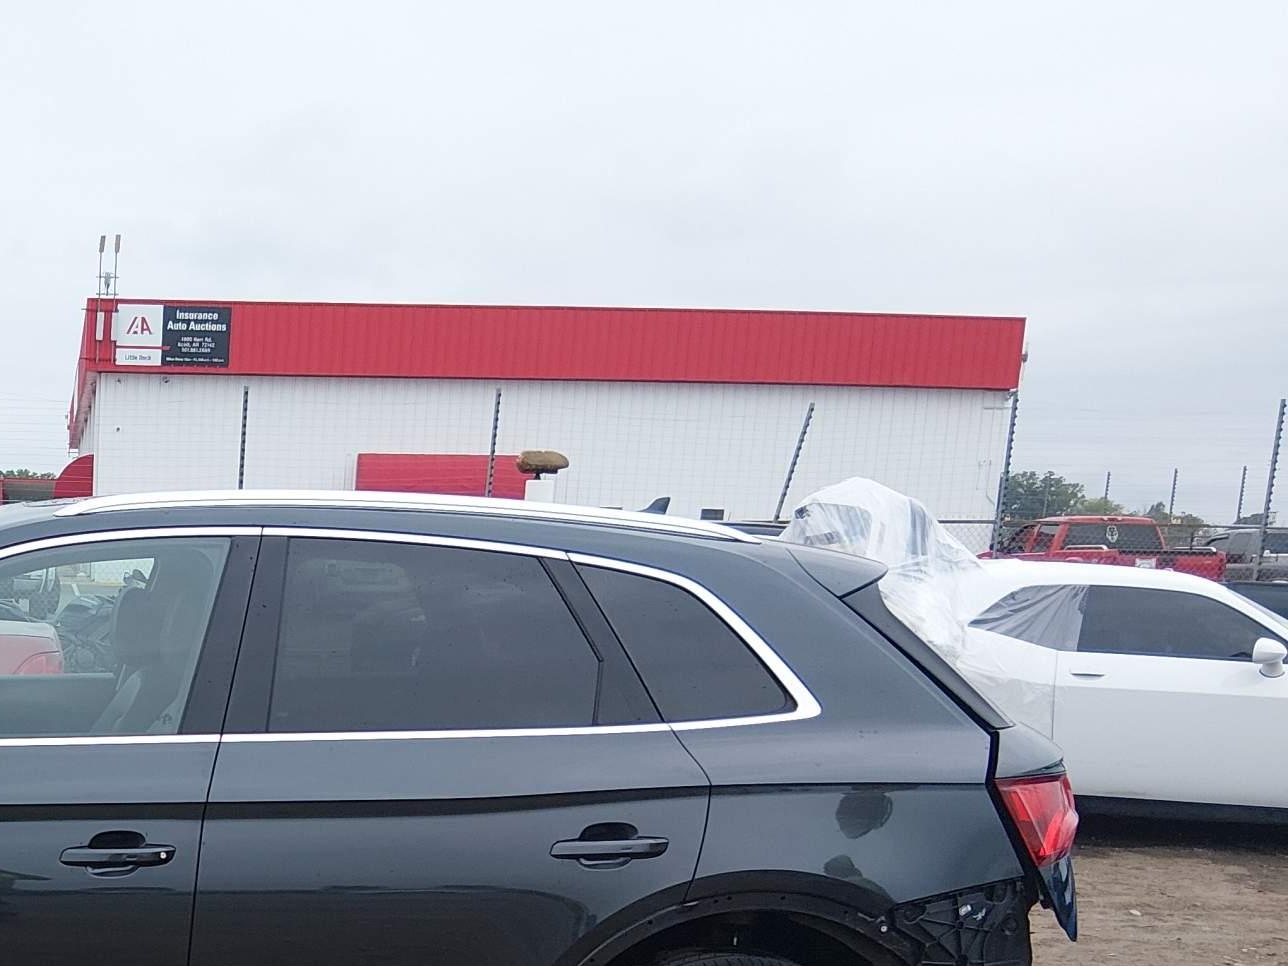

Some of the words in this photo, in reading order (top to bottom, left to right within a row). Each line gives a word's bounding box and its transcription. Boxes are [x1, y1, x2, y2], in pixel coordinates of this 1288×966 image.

[176, 309, 219, 321] Insurance
[167, 321, 188, 331] Auto
[189, 321, 227, 332] Auctions
